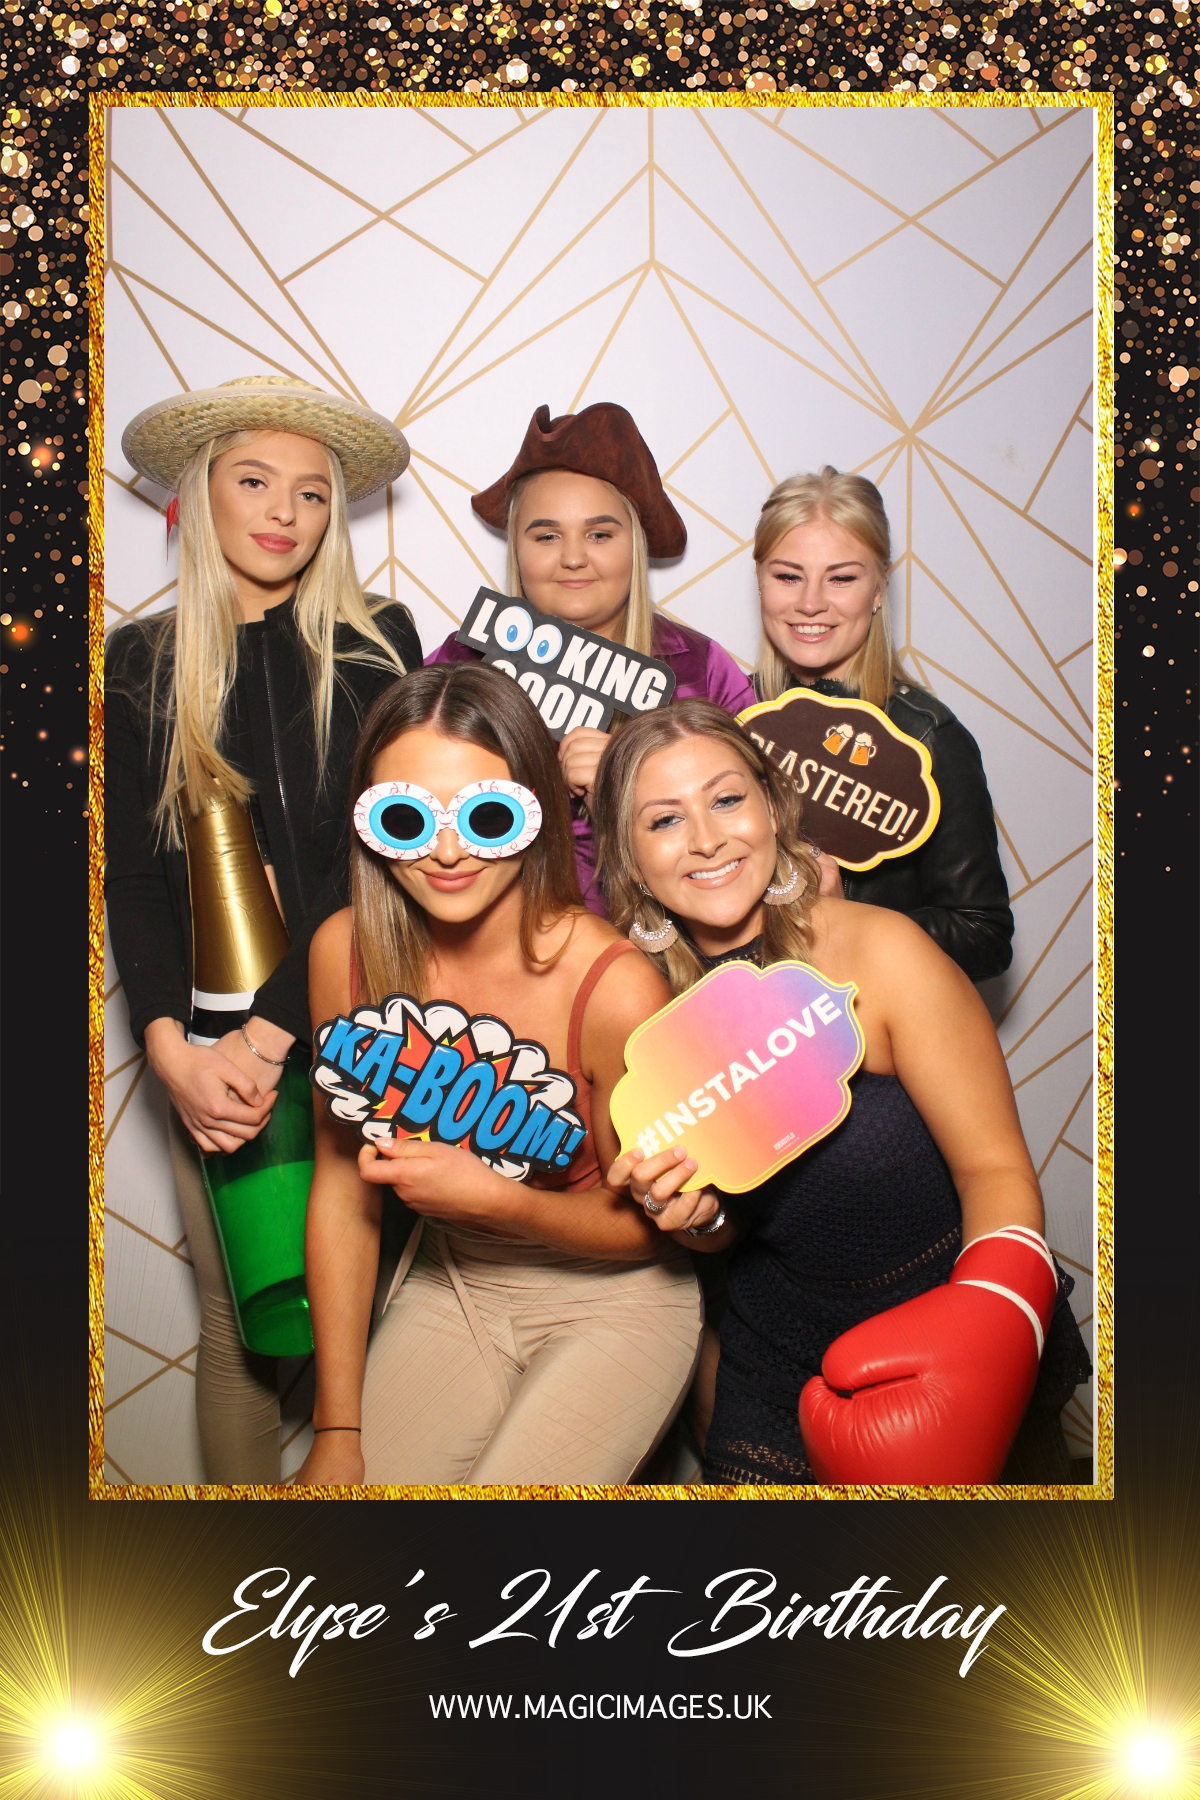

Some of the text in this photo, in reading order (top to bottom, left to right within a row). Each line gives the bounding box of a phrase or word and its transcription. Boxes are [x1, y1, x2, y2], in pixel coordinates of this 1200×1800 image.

[468, 598, 667, 711] LOOKING
[320, 1017, 587, 1167] KA-BOOM!
[636, 992, 843, 1161] #INSTALOVE
